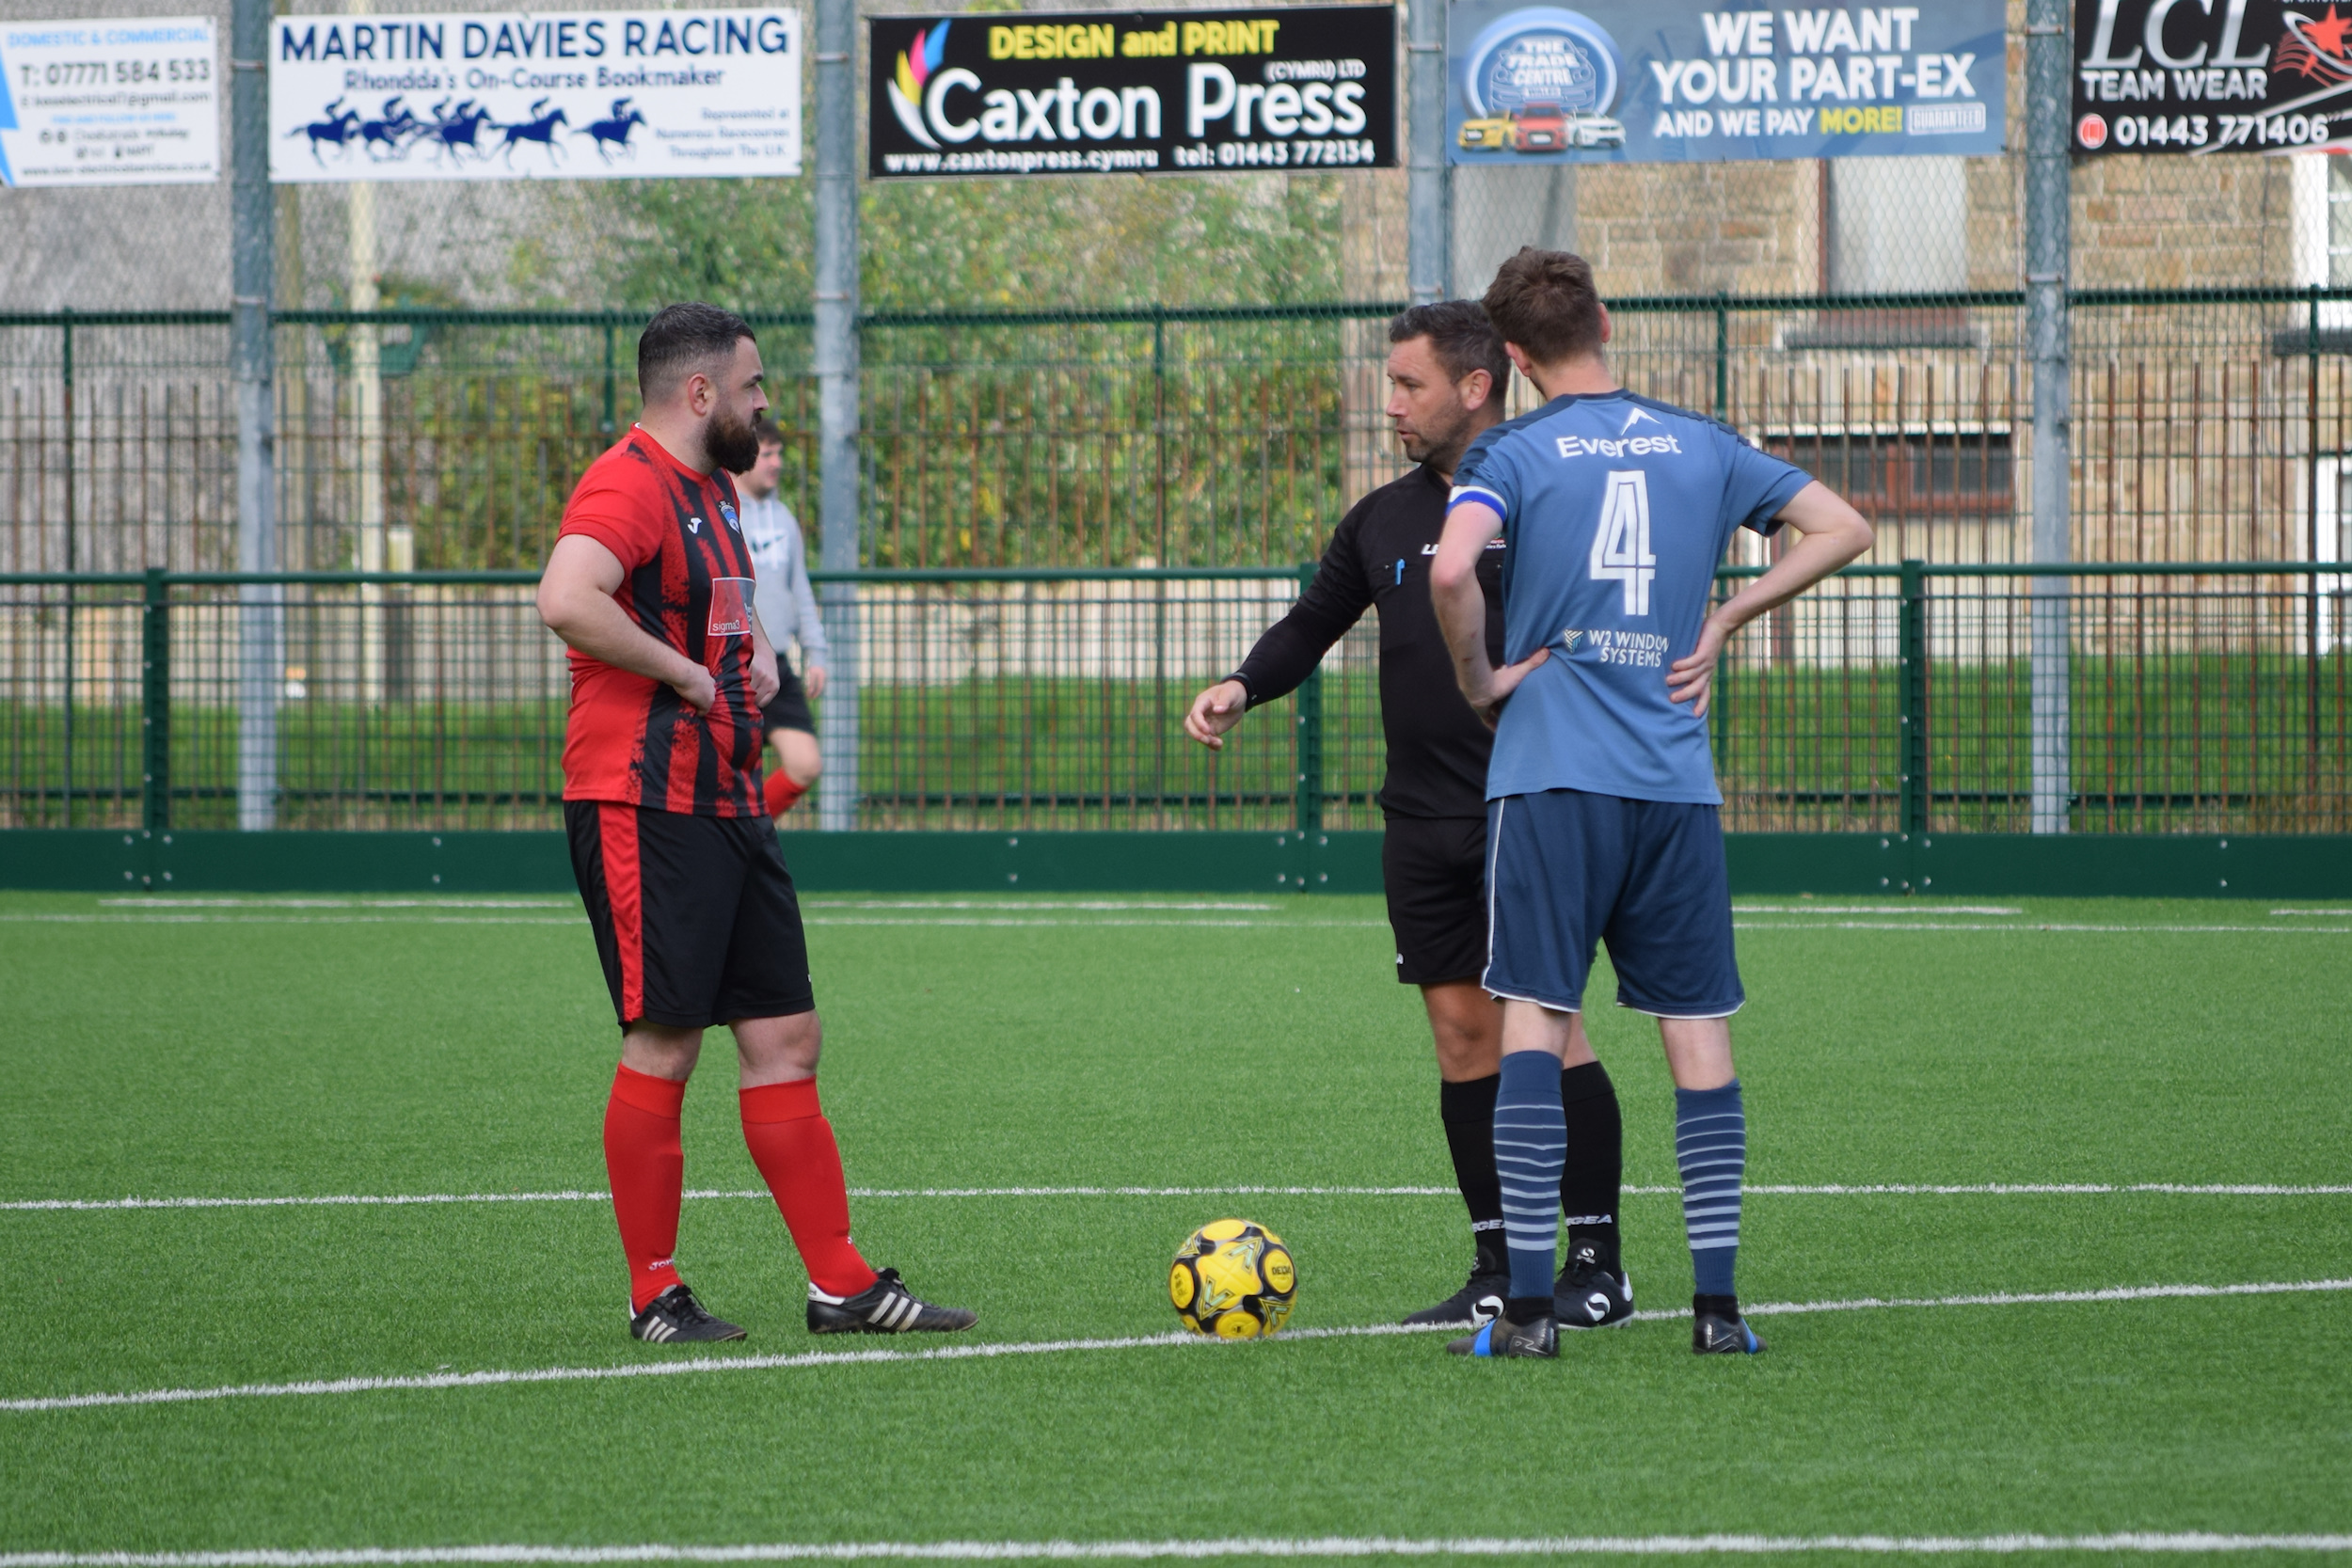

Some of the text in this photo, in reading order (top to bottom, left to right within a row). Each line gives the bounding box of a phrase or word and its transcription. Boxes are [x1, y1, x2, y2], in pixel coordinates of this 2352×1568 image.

[8, 27, 210, 47] DOMESTIC & COMMERCIAL
[282, 16, 788, 61] MARTIN DAVIES RACING
[989, 20, 1279, 59] DESIGN and PRINT
[1702, 8, 1919, 55] WE WANT
[1507, 53, 1581, 70] TRADE
[1523, 40, 1565, 54] THE
[19, 57, 211, 86] T: 07771 584 533
[343, 62, 726, 91] Rhondda's On-Course Bookmaker
[1264, 58, 1367, 83] (CYMRU) LTD
[1513, 68, 1575, 87] CENTRE
[1649, 53, 1977, 104] YOUR PART-EX
[2079, 68, 2270, 102] TEAM WEAR
[925, 62, 1367, 143] Caxton Press
[1654, 105, 1983, 137] AND WE PAY MORE! GUARANTEED
[2114, 113, 2330, 146] 01443 771406
[883, 149, 1160, 173] www.caxtonpress.cymru
[1173, 141, 1216, 166] tel:
[1556, 434, 1682, 458] Everest
[1589, 470, 1657, 616] 4
[712, 619, 740, 633] sigma3
[1588, 629, 1612, 647] W2
[1599, 646, 1662, 668] SYSTEMS
